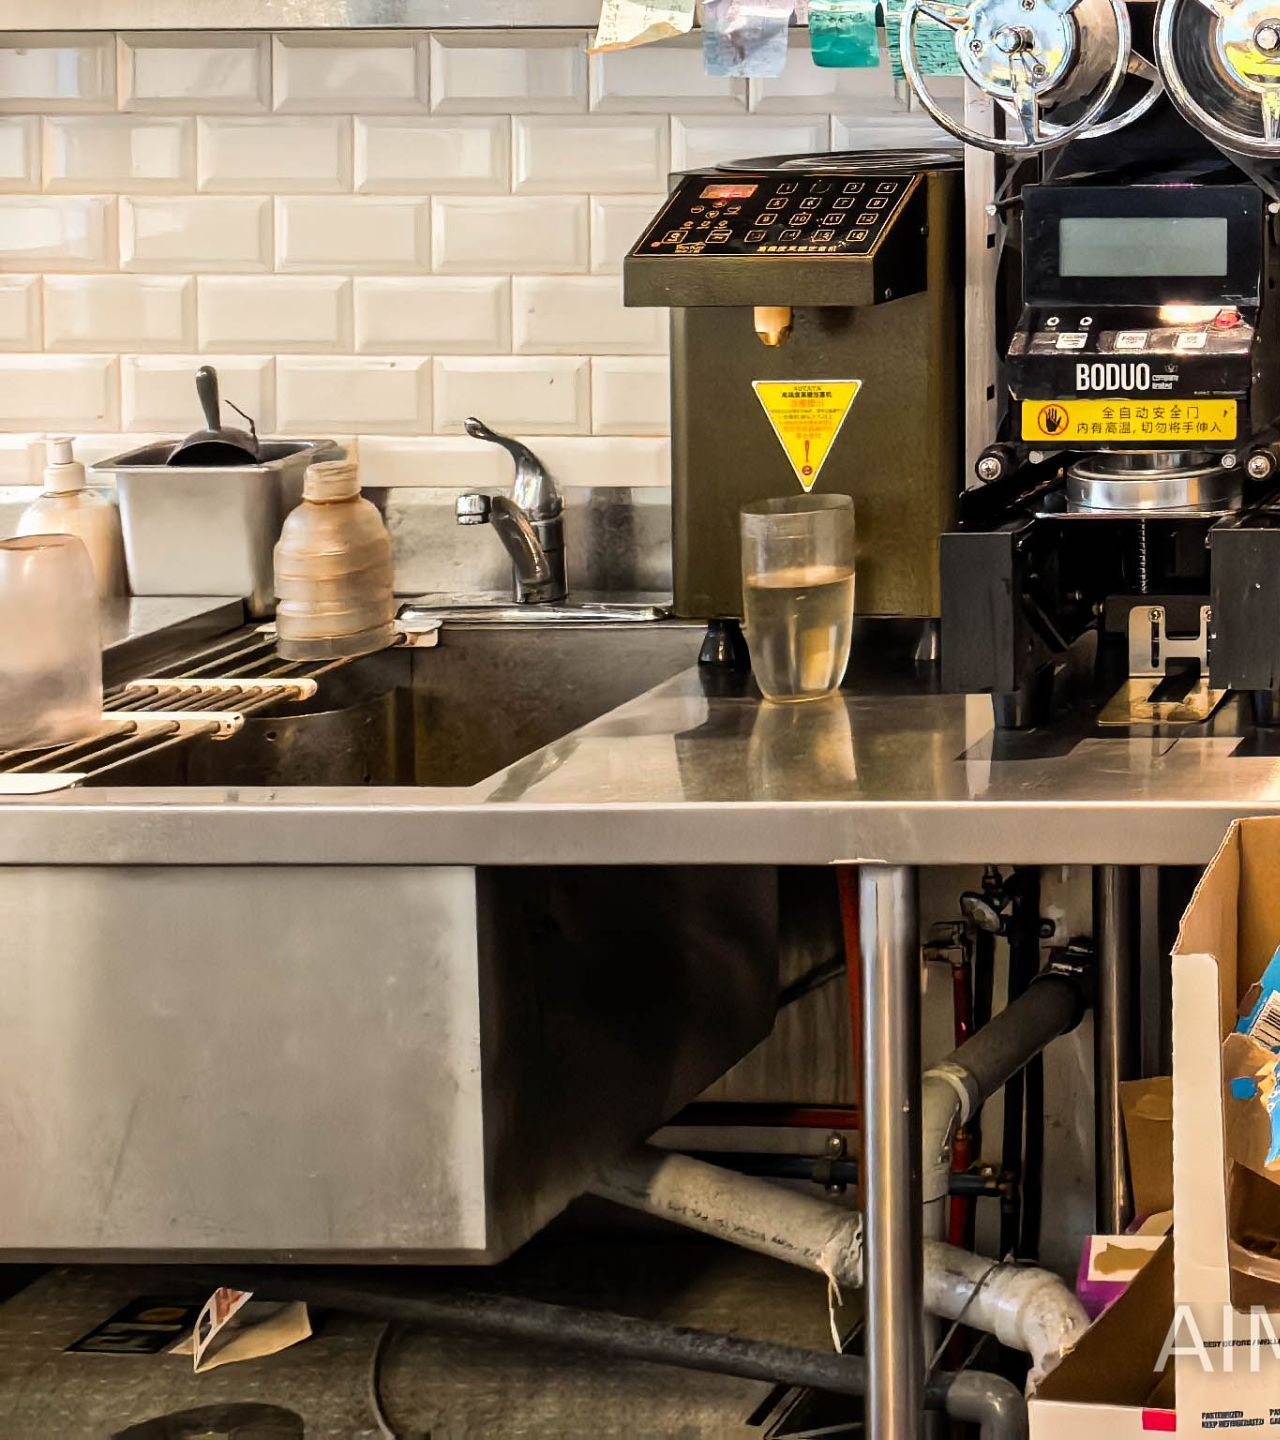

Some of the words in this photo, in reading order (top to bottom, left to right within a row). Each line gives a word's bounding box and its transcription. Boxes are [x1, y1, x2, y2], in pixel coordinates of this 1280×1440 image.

[1076, 363, 1150, 391] BODUO
[1102, 406, 1200, 420] 全自动安全门
